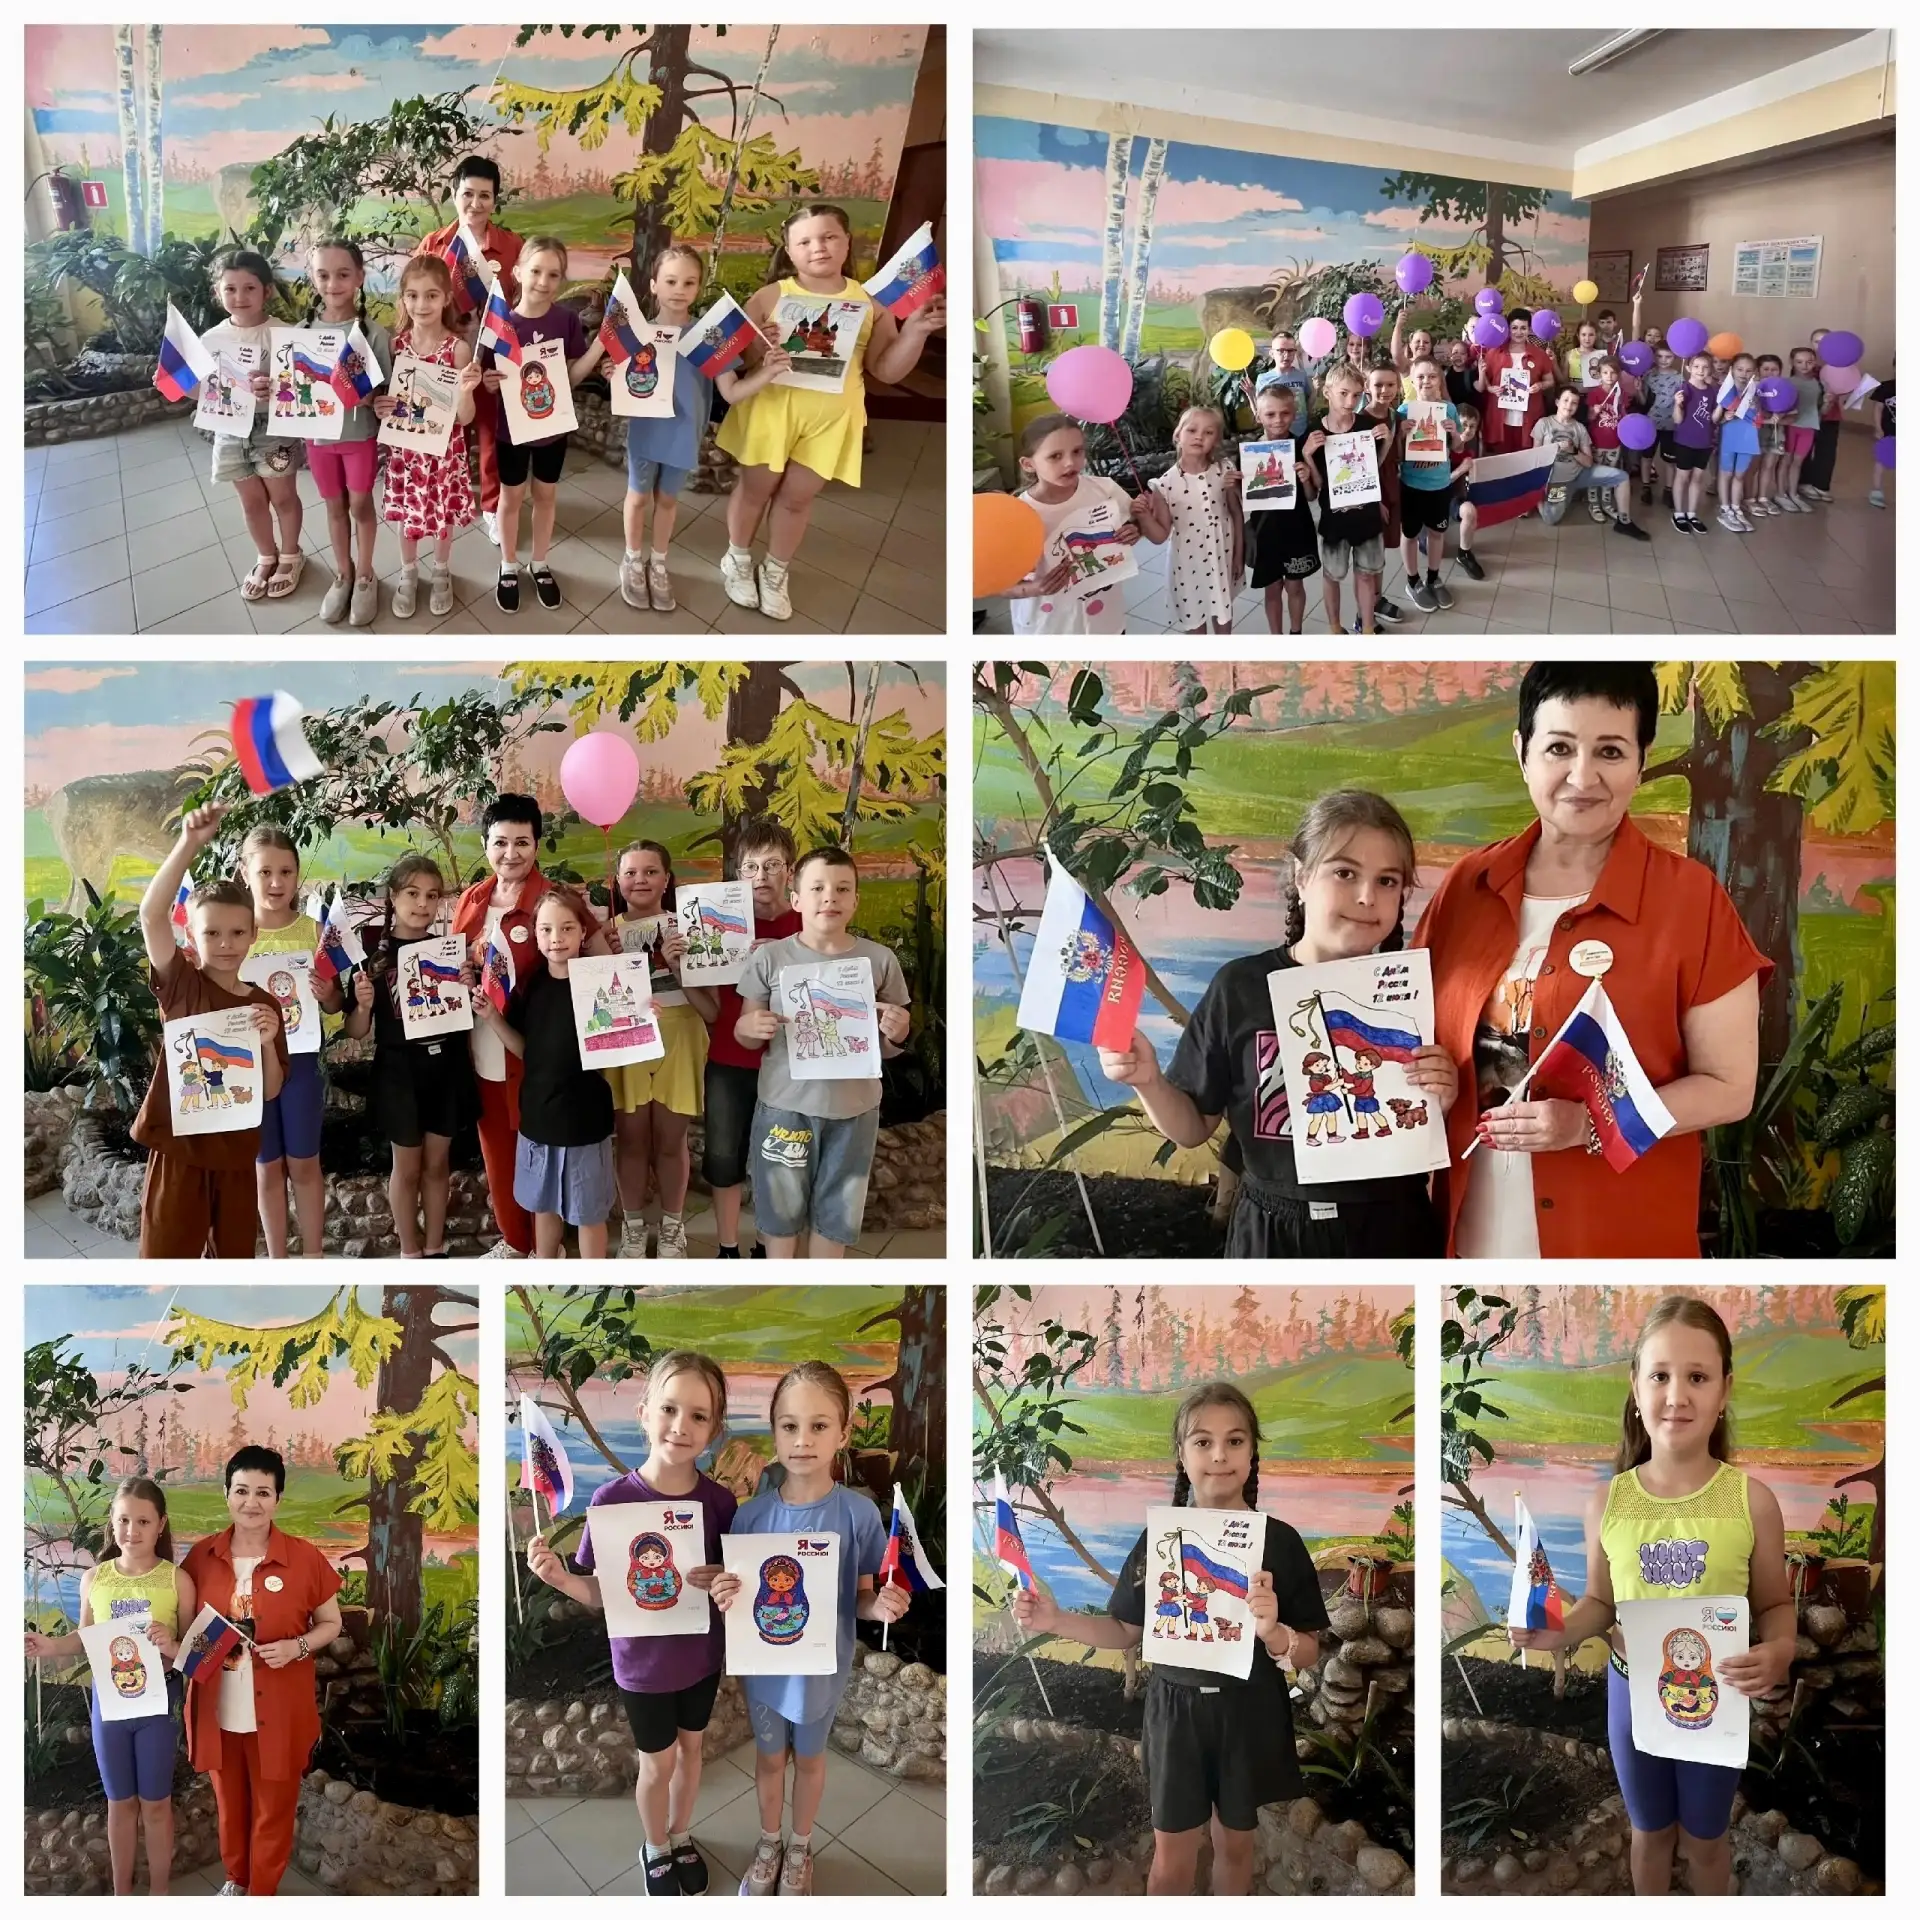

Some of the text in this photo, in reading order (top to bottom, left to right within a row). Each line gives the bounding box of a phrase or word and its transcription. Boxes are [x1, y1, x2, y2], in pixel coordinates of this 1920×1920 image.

[539, 347, 546, 356] Я
[1372, 993, 1384, 1003] 12
[1581, 1065, 1614, 1127] РОССИЯ
[663, 1510, 675, 1525] Я
[797, 1539, 809, 1550] Я
[1639, 1540, 1709, 1565] WHAT
[1642, 1560, 1706, 1585] NOW?
[1701, 1606, 1714, 1623] Я
